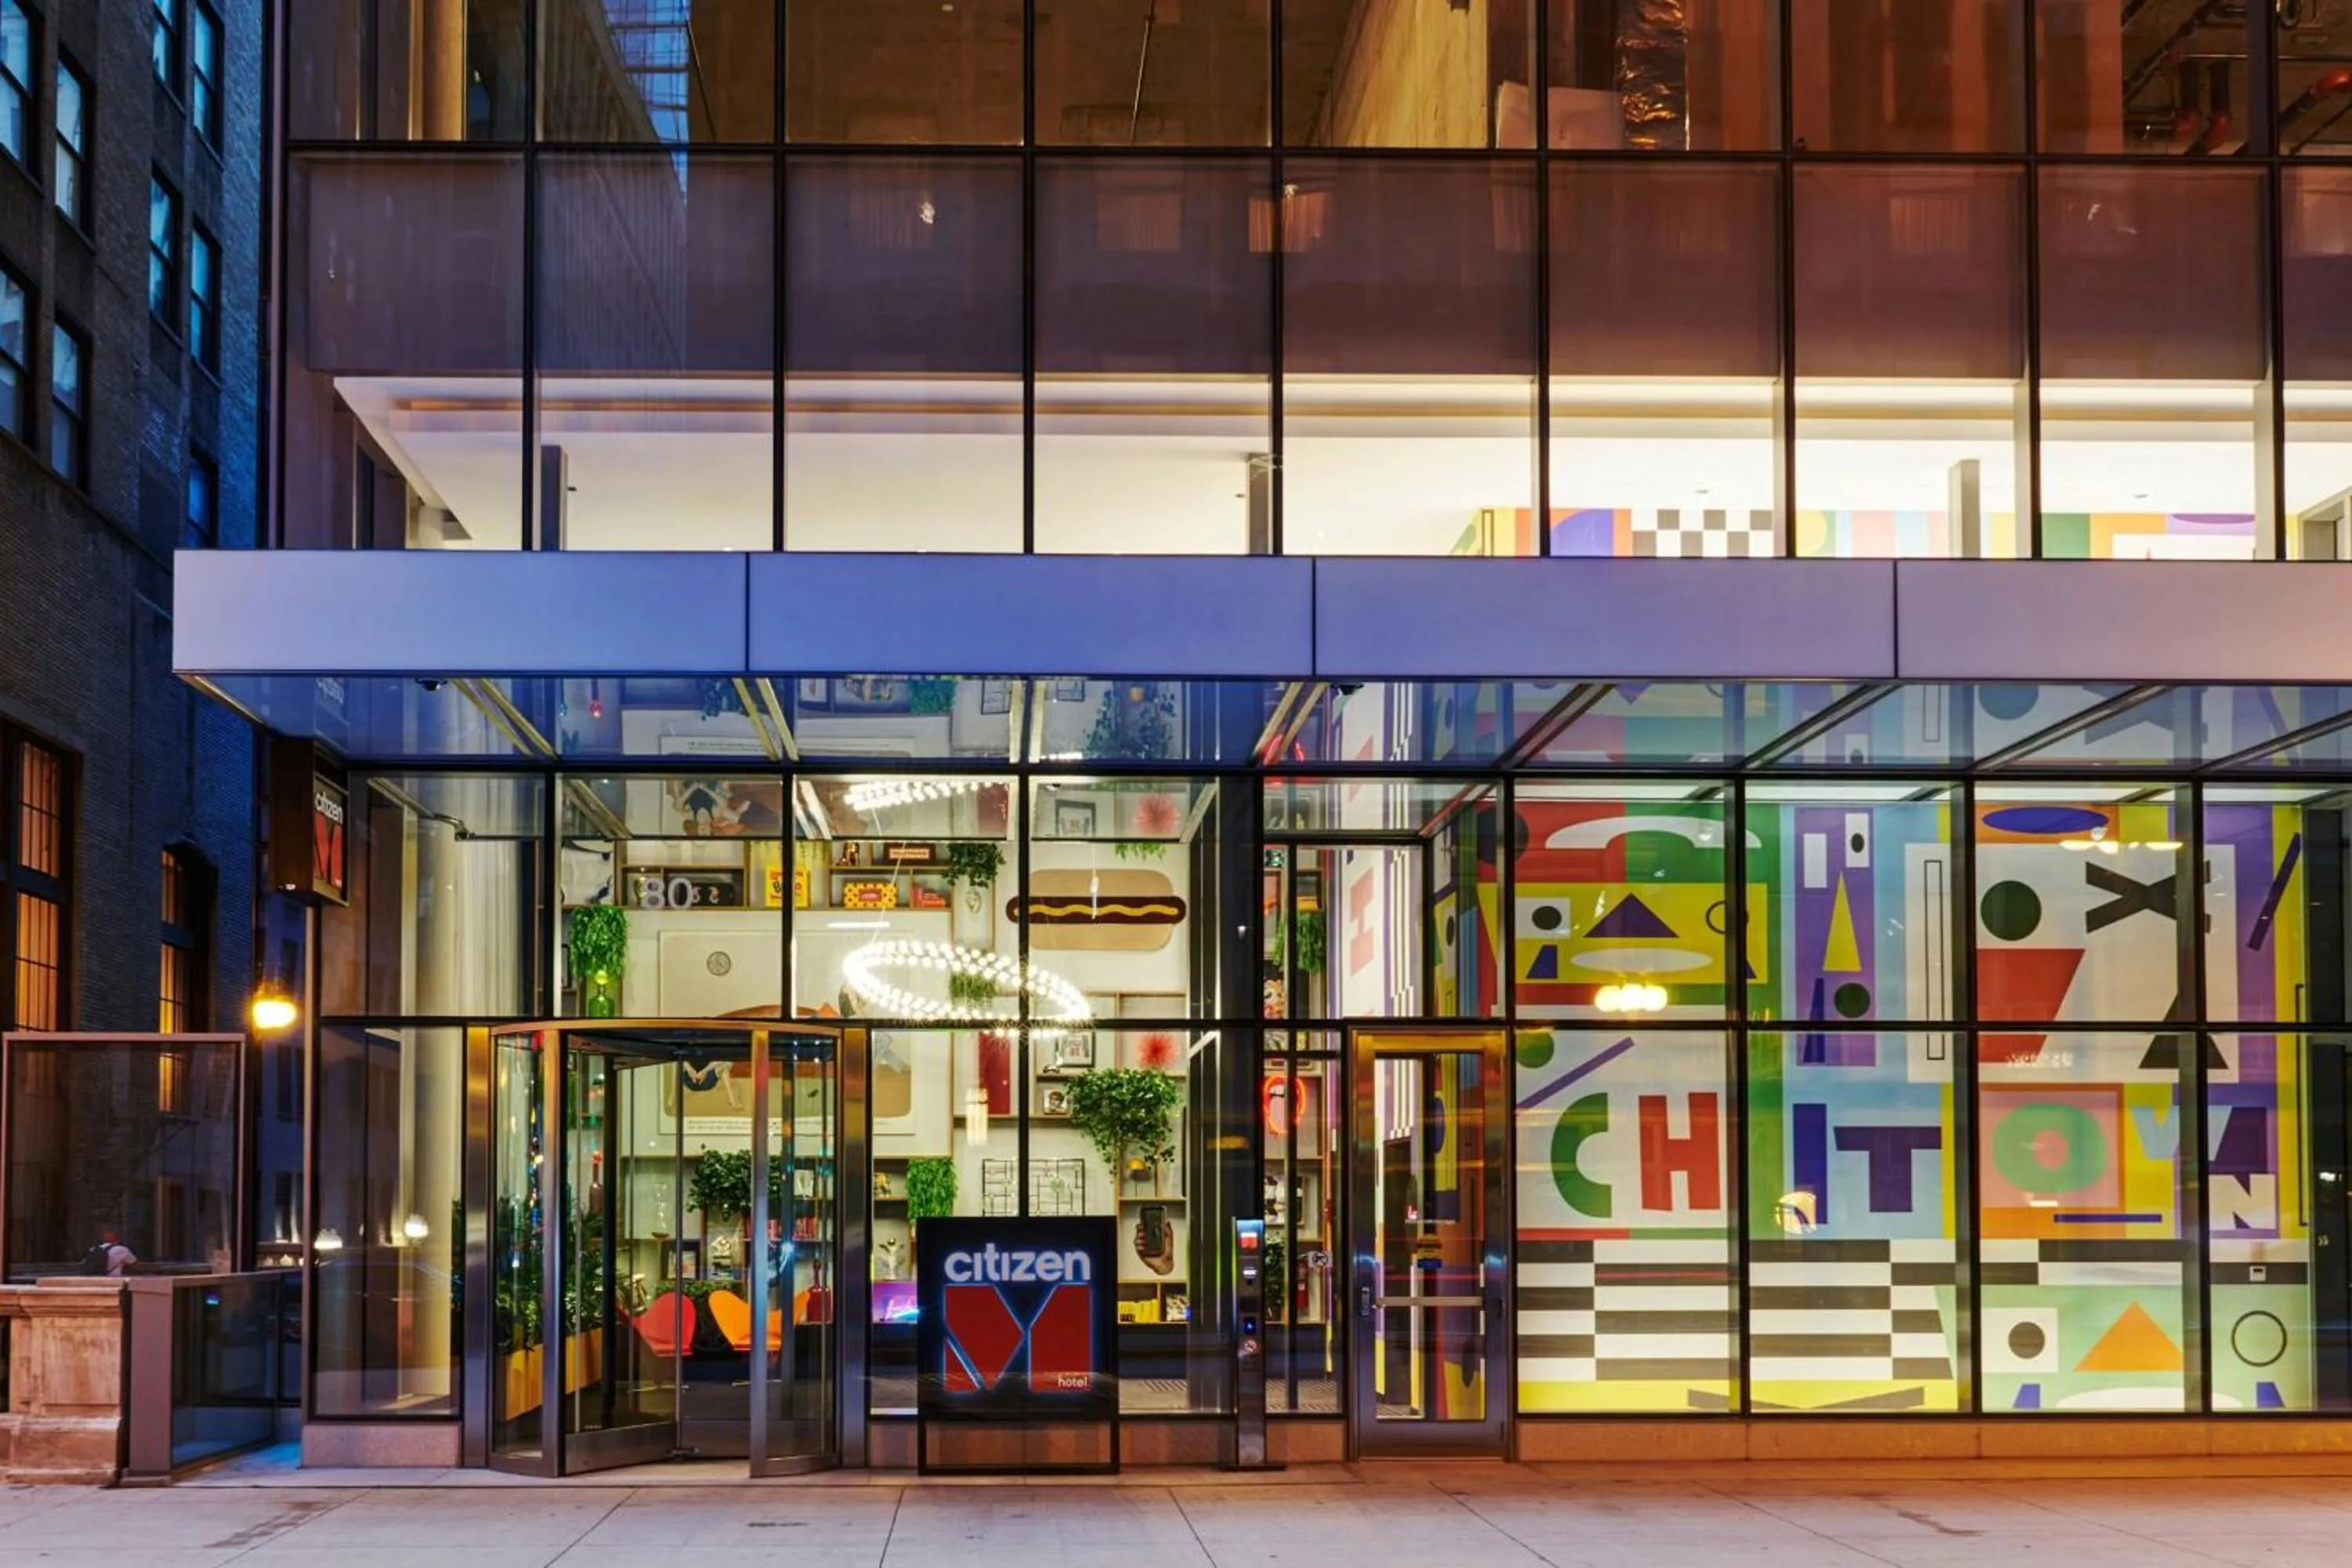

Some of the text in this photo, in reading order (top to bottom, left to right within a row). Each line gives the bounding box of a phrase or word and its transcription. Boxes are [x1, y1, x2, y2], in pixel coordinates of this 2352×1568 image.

[314, 790, 343, 825] citizen
[944, 1243, 1091, 1282] citizen
[1058, 1375, 1087, 1388] hotel
